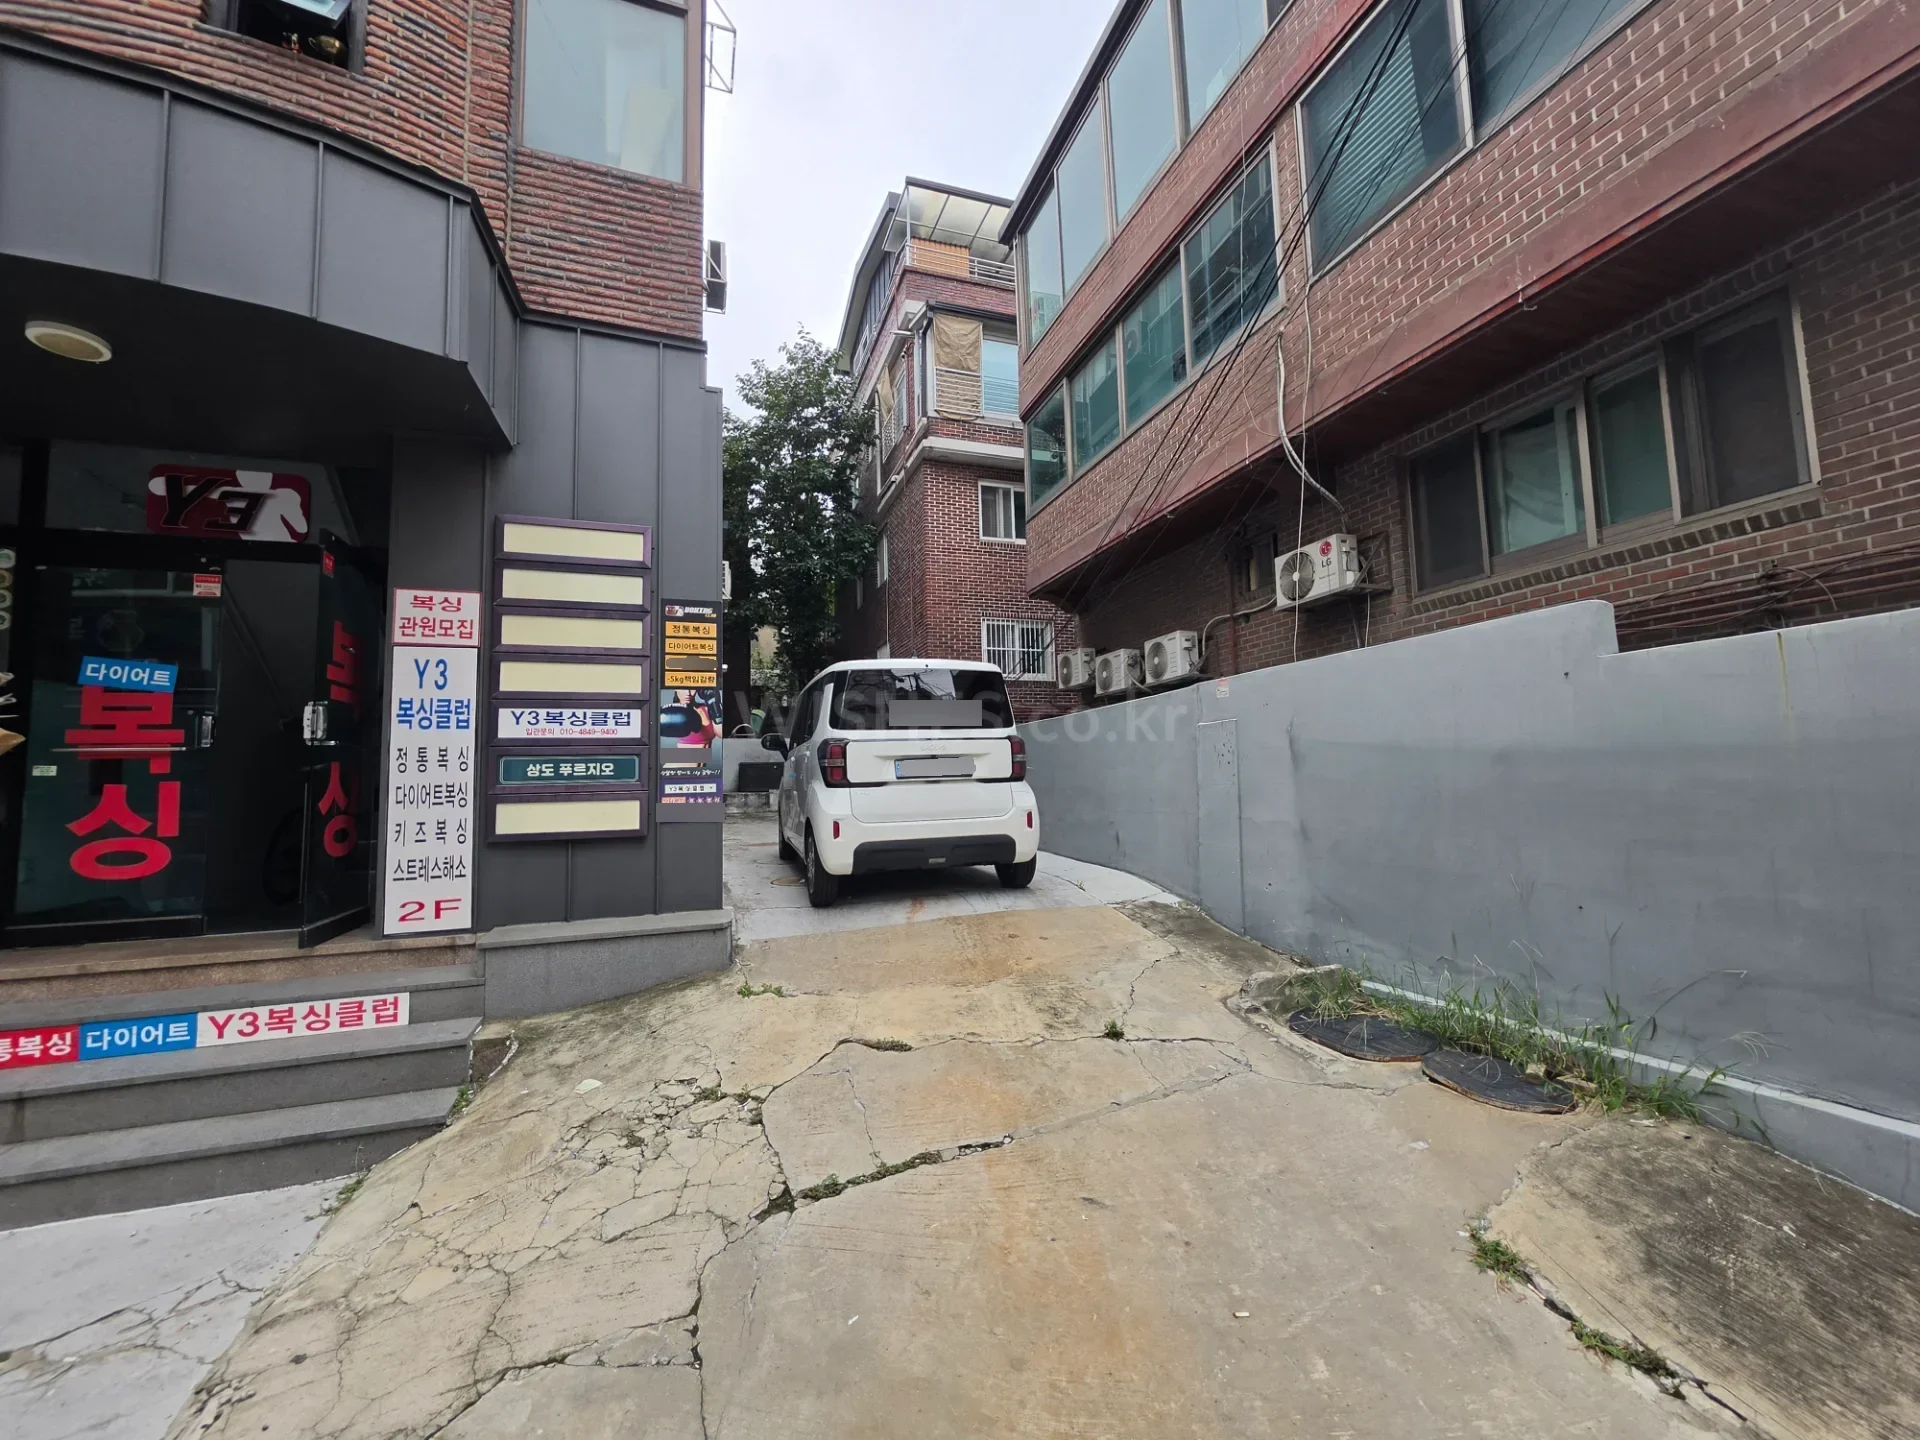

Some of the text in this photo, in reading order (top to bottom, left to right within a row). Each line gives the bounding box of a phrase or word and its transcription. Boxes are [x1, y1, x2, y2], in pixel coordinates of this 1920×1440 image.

[1321, 558, 1332, 568] LG
[410, 595, 462, 612] 복싱
[399, 617, 474, 639] 관원모집
[668, 642, 714, 652] 다이어트복싱
[85, 663, 171, 686] 다이어트
[414, 659, 448, 690] Y3
[396, 697, 471, 730] 복싱클럽
[510, 710, 632, 727] Y3복싱클럽
[525, 728, 555, 736] 입관문의
[526, 762, 614, 777] 상도 푸르지오
[64, 685, 186, 880] 복싱
[395, 782, 468, 810] 다이어트복싱
[393, 855, 467, 882] 스트레스해소
[398, 899, 462, 922] 2F
[86, 1022, 191, 1051] 다이어트
[208, 996, 400, 1041] Y3복싱클럽
